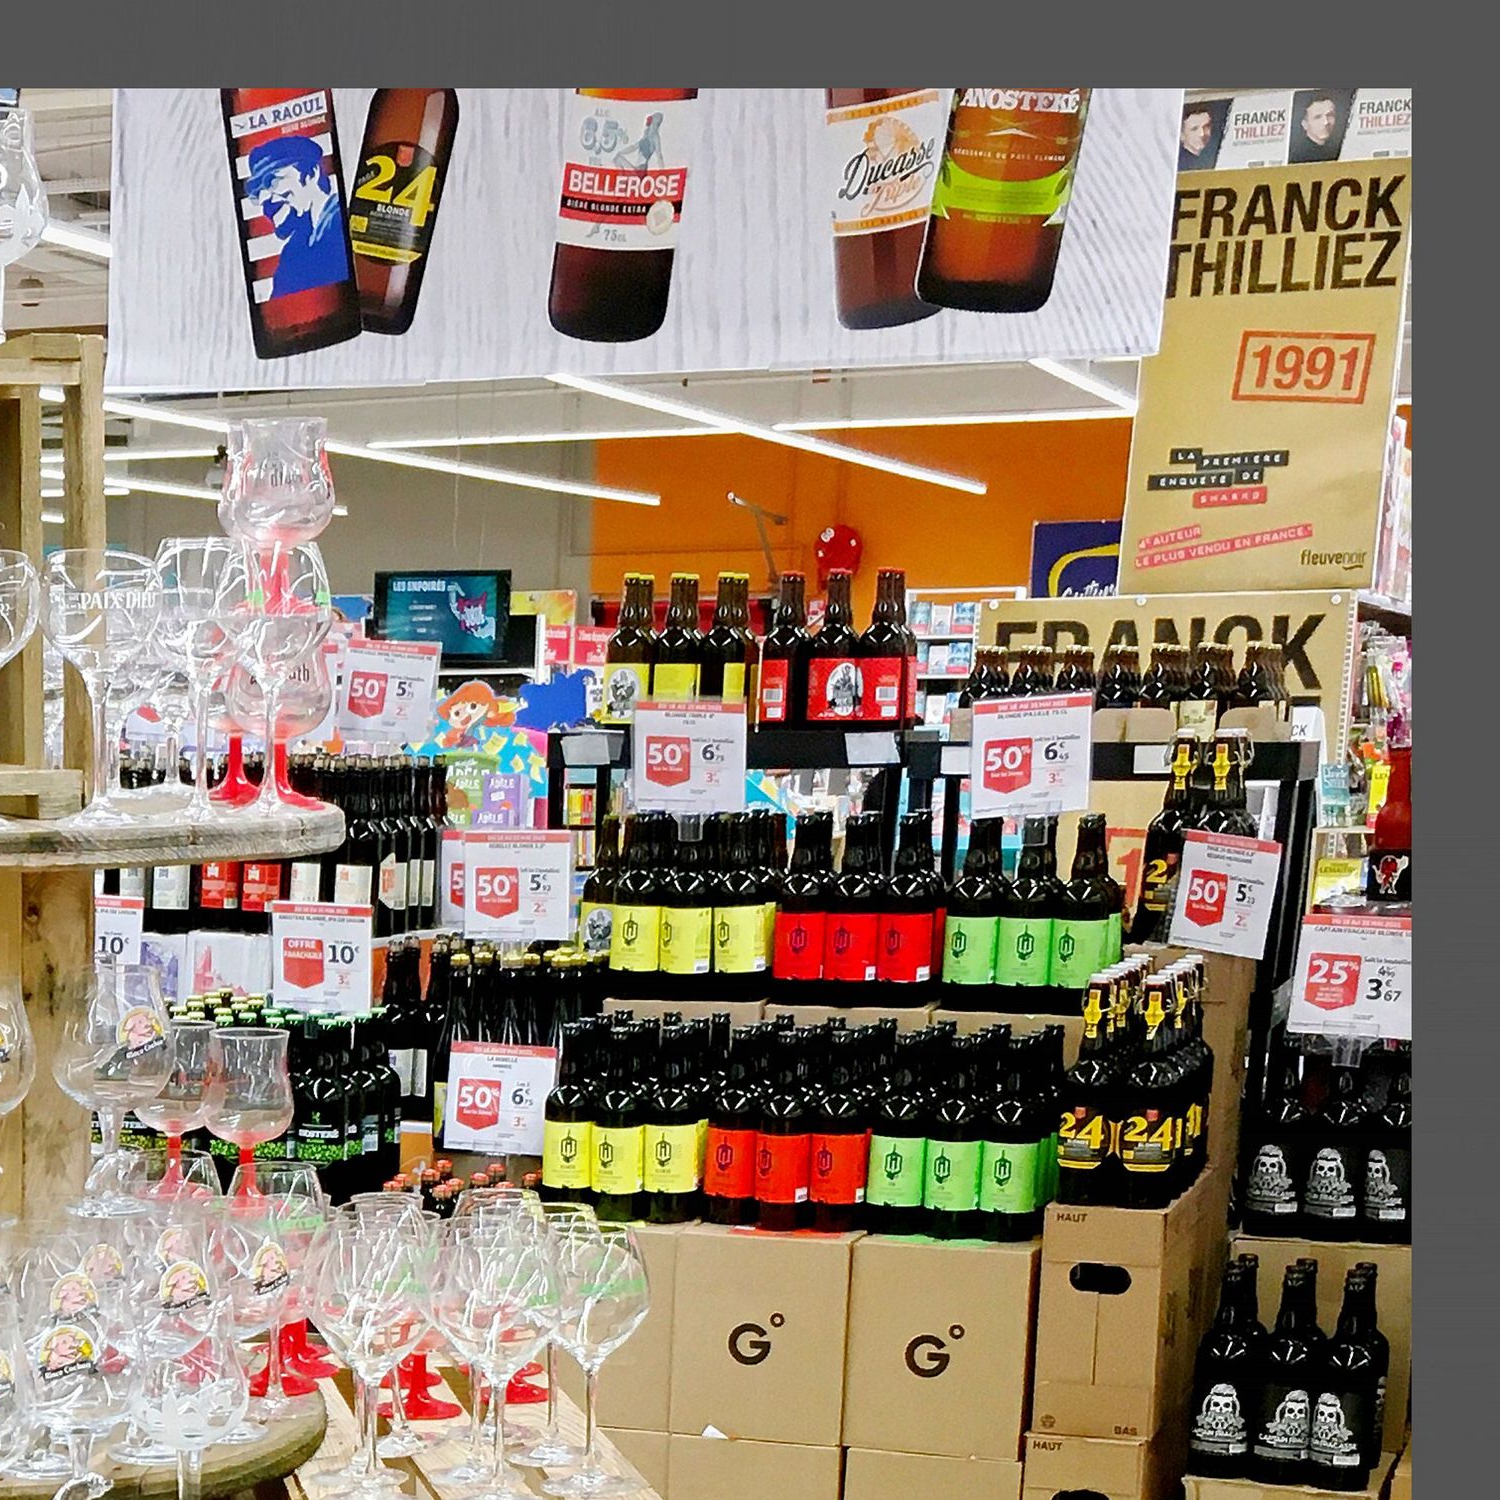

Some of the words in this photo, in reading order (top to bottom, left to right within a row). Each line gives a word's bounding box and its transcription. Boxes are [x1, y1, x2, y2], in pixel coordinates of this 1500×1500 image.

[249, 113, 267, 129] LA
[272, 97, 324, 123] RAOUL
[1358, 99, 1412, 115] FRANCK
[1234, 109, 1286, 126] FRANCK
[1359, 113, 1411, 129] THILLIEZ
[1234, 124, 1285, 140] THILLIEZ
[838, 137, 935, 201] Ducasse
[355, 155, 438, 227] 24
[569, 170, 681, 198] BELLEROSE
[376, 203, 410, 217] BLONDE
[1170, 174, 1406, 240] FRANCK
[1165, 230, 1402, 300] THILLIEZ
[1250, 344, 1362, 393] 1991
[1178, 452, 1195, 460] LA
[1242, 471, 1259, 480] DE
[1200, 492, 1260, 504] SHARKO
[1153, 527, 1201, 546] AUTEUR
[1135, 556, 1150, 568] LE
[1153, 551, 1185, 565] PLUS
[1189, 541, 1231, 557] VENDU
[1234, 538, 1251, 548] EN
[82, 590, 113, 609] PAIX
[287, 939, 315, 949] OFFRE
[1309, 959, 1359, 985] 25%
[459, 1085, 499, 1108] 50%
[1059, 1112, 1105, 1143] 24
[1122, 1116, 1173, 1148] 24
[1057, 1212, 1087, 1224] HAUT
[1113, 1425, 1138, 1437] BAS
[1032, 1440, 1063, 1452] HAUT
